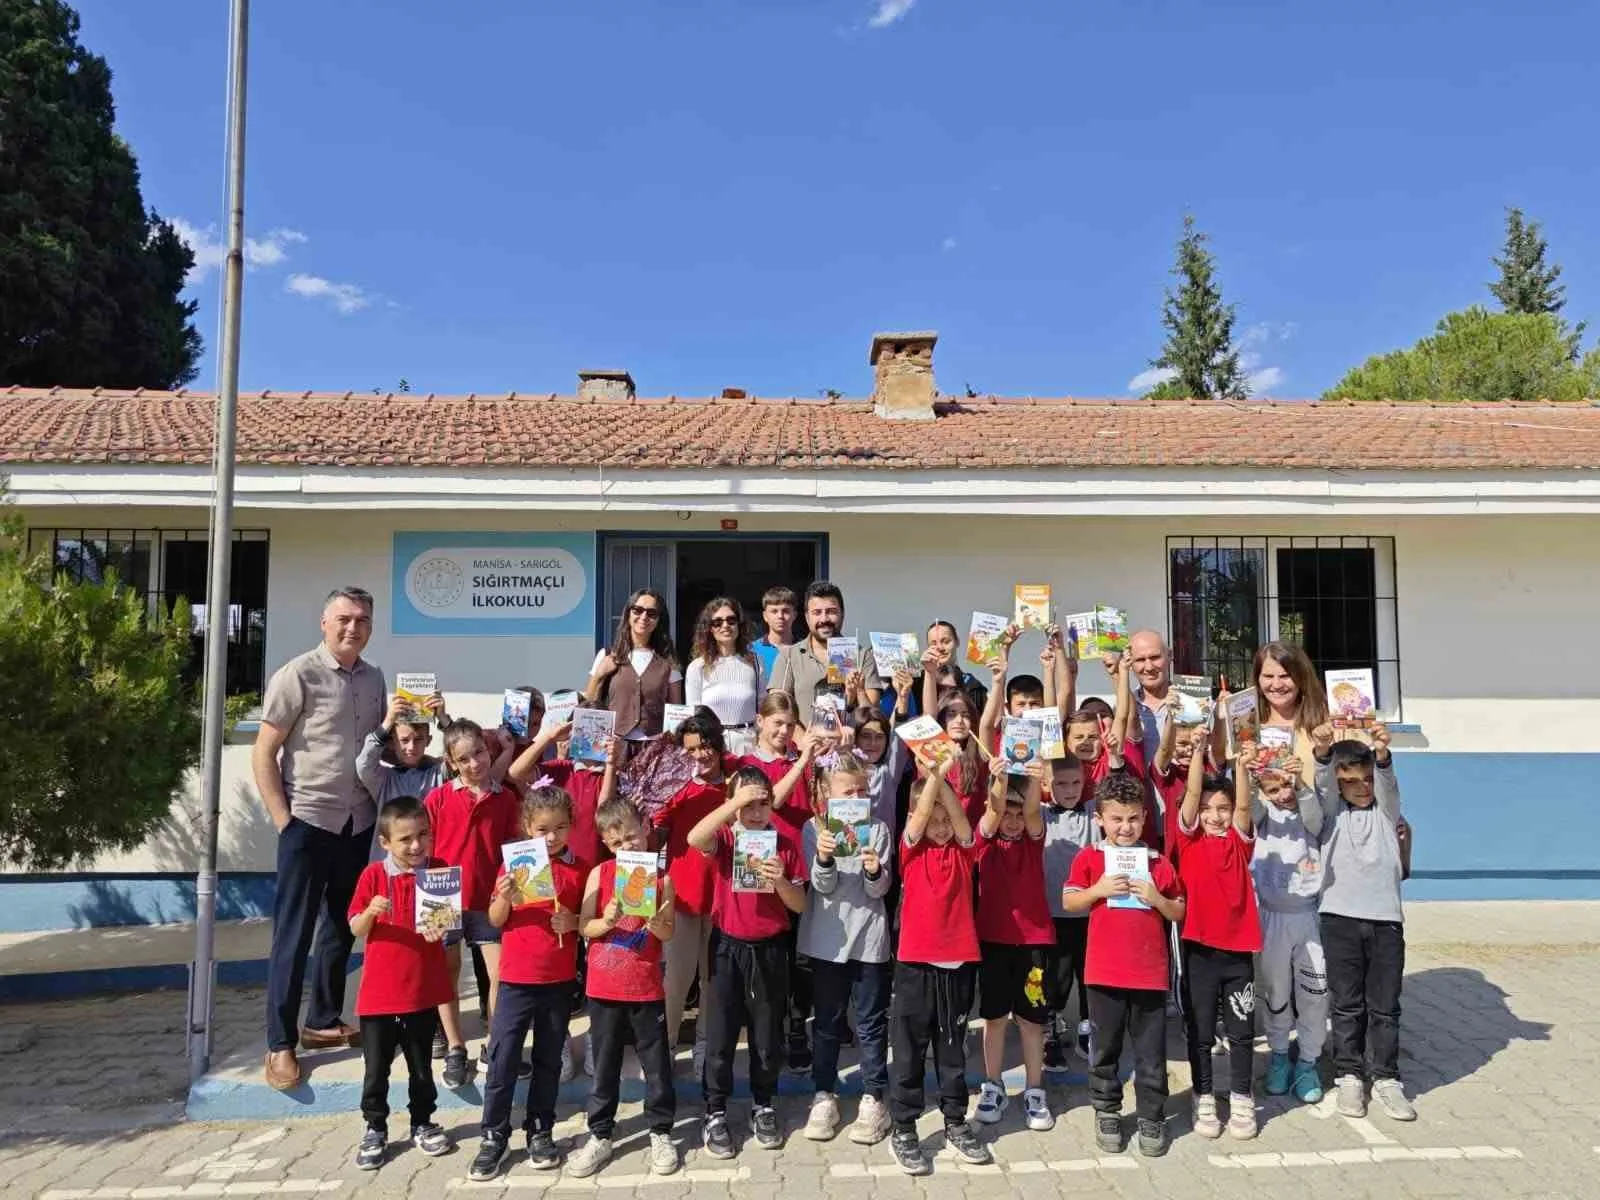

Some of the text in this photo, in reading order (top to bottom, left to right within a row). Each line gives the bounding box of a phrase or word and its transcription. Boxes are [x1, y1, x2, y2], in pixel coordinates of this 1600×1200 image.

[473, 558, 512, 569] MANİSA
[520, 558, 563, 569] SARIGÖL
[472, 574, 565, 591] SIĞIRTMAÇLI
[472, 592, 545, 607] İLKOKULU
